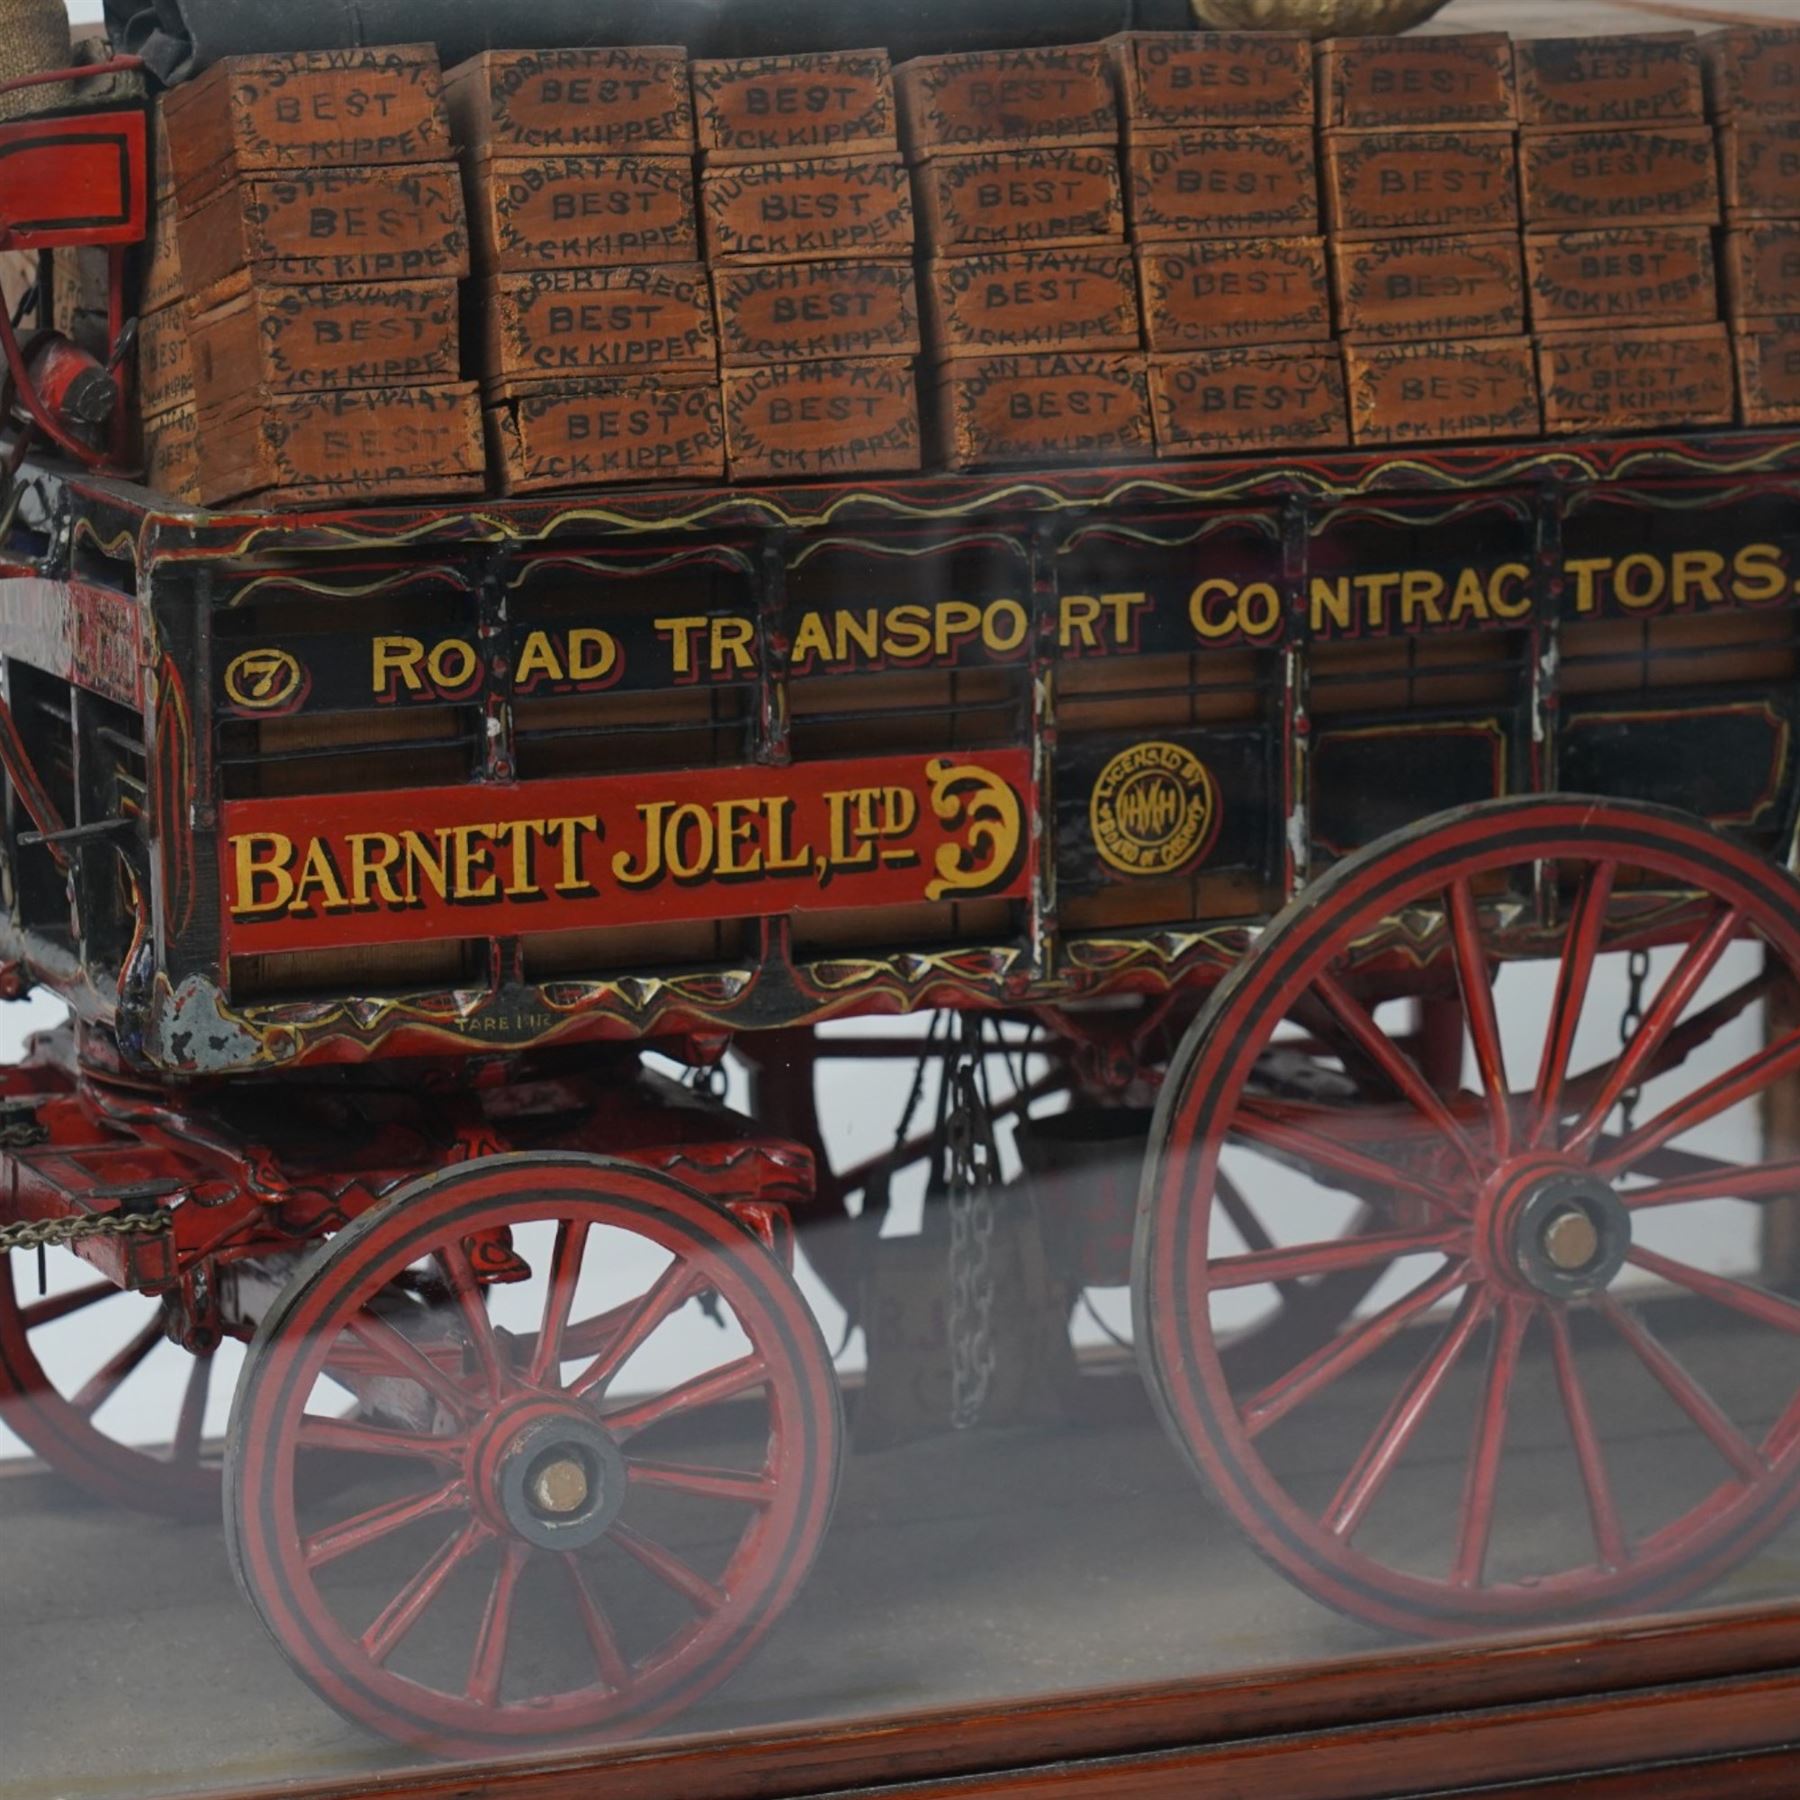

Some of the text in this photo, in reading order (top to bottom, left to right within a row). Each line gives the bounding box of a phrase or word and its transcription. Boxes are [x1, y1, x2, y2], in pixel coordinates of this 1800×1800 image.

[542, 79, 651, 103] BEST
[1171, 64, 1270, 89] BEST
[1372, 68, 1479, 94] BEST
[276, 93, 397, 123] BEST
[745, 85, 856, 114] BEST
[969, 79, 1075, 109] BEST
[573, 103, 692, 145] KIPPERS
[1571, 155, 1656, 178] BEST
[497, 158, 607, 216] ROBERT
[978, 181, 1081, 209] BEST
[1176, 169, 1284, 194] BEST
[1379, 169, 1492, 195] BEST
[552, 191, 657, 220] BEST
[761, 193, 871, 222] BEST
[310, 207, 427, 238] BEST
[718, 198, 913, 252] WICK KIPPERS
[501, 222, 581, 260] WICK
[1581, 253, 1667, 278] BEST
[986, 279, 1087, 309] BEST
[1193, 271, 1297, 298] BEST
[1387, 273, 1487, 298] BEST
[550, 305, 663, 334] BEST
[773, 292, 875, 323] BEST
[313, 318, 427, 345] BEST
[589, 320, 716, 366] KIPPERS
[1030, 353, 1148, 398] TAYLOR
[1402, 377, 1506, 401] BEST
[1593, 367, 1680, 389] BEST
[769, 396, 884, 424] BEST
[1009, 391, 1117, 419] BEST
[1202, 384, 1317, 412] BEST
[568, 410, 679, 440] BEST
[323, 426, 449, 459] BEST
[602, 426, 723, 471] KIPPERS
[371, 627, 620, 698] ROAD
[654, 591, 1150, 677] TRANSPORT
[242, 660, 285, 697] 7
[228, 814, 602, 919] BARNETT
[454, 1016, 510, 1032] TARE
